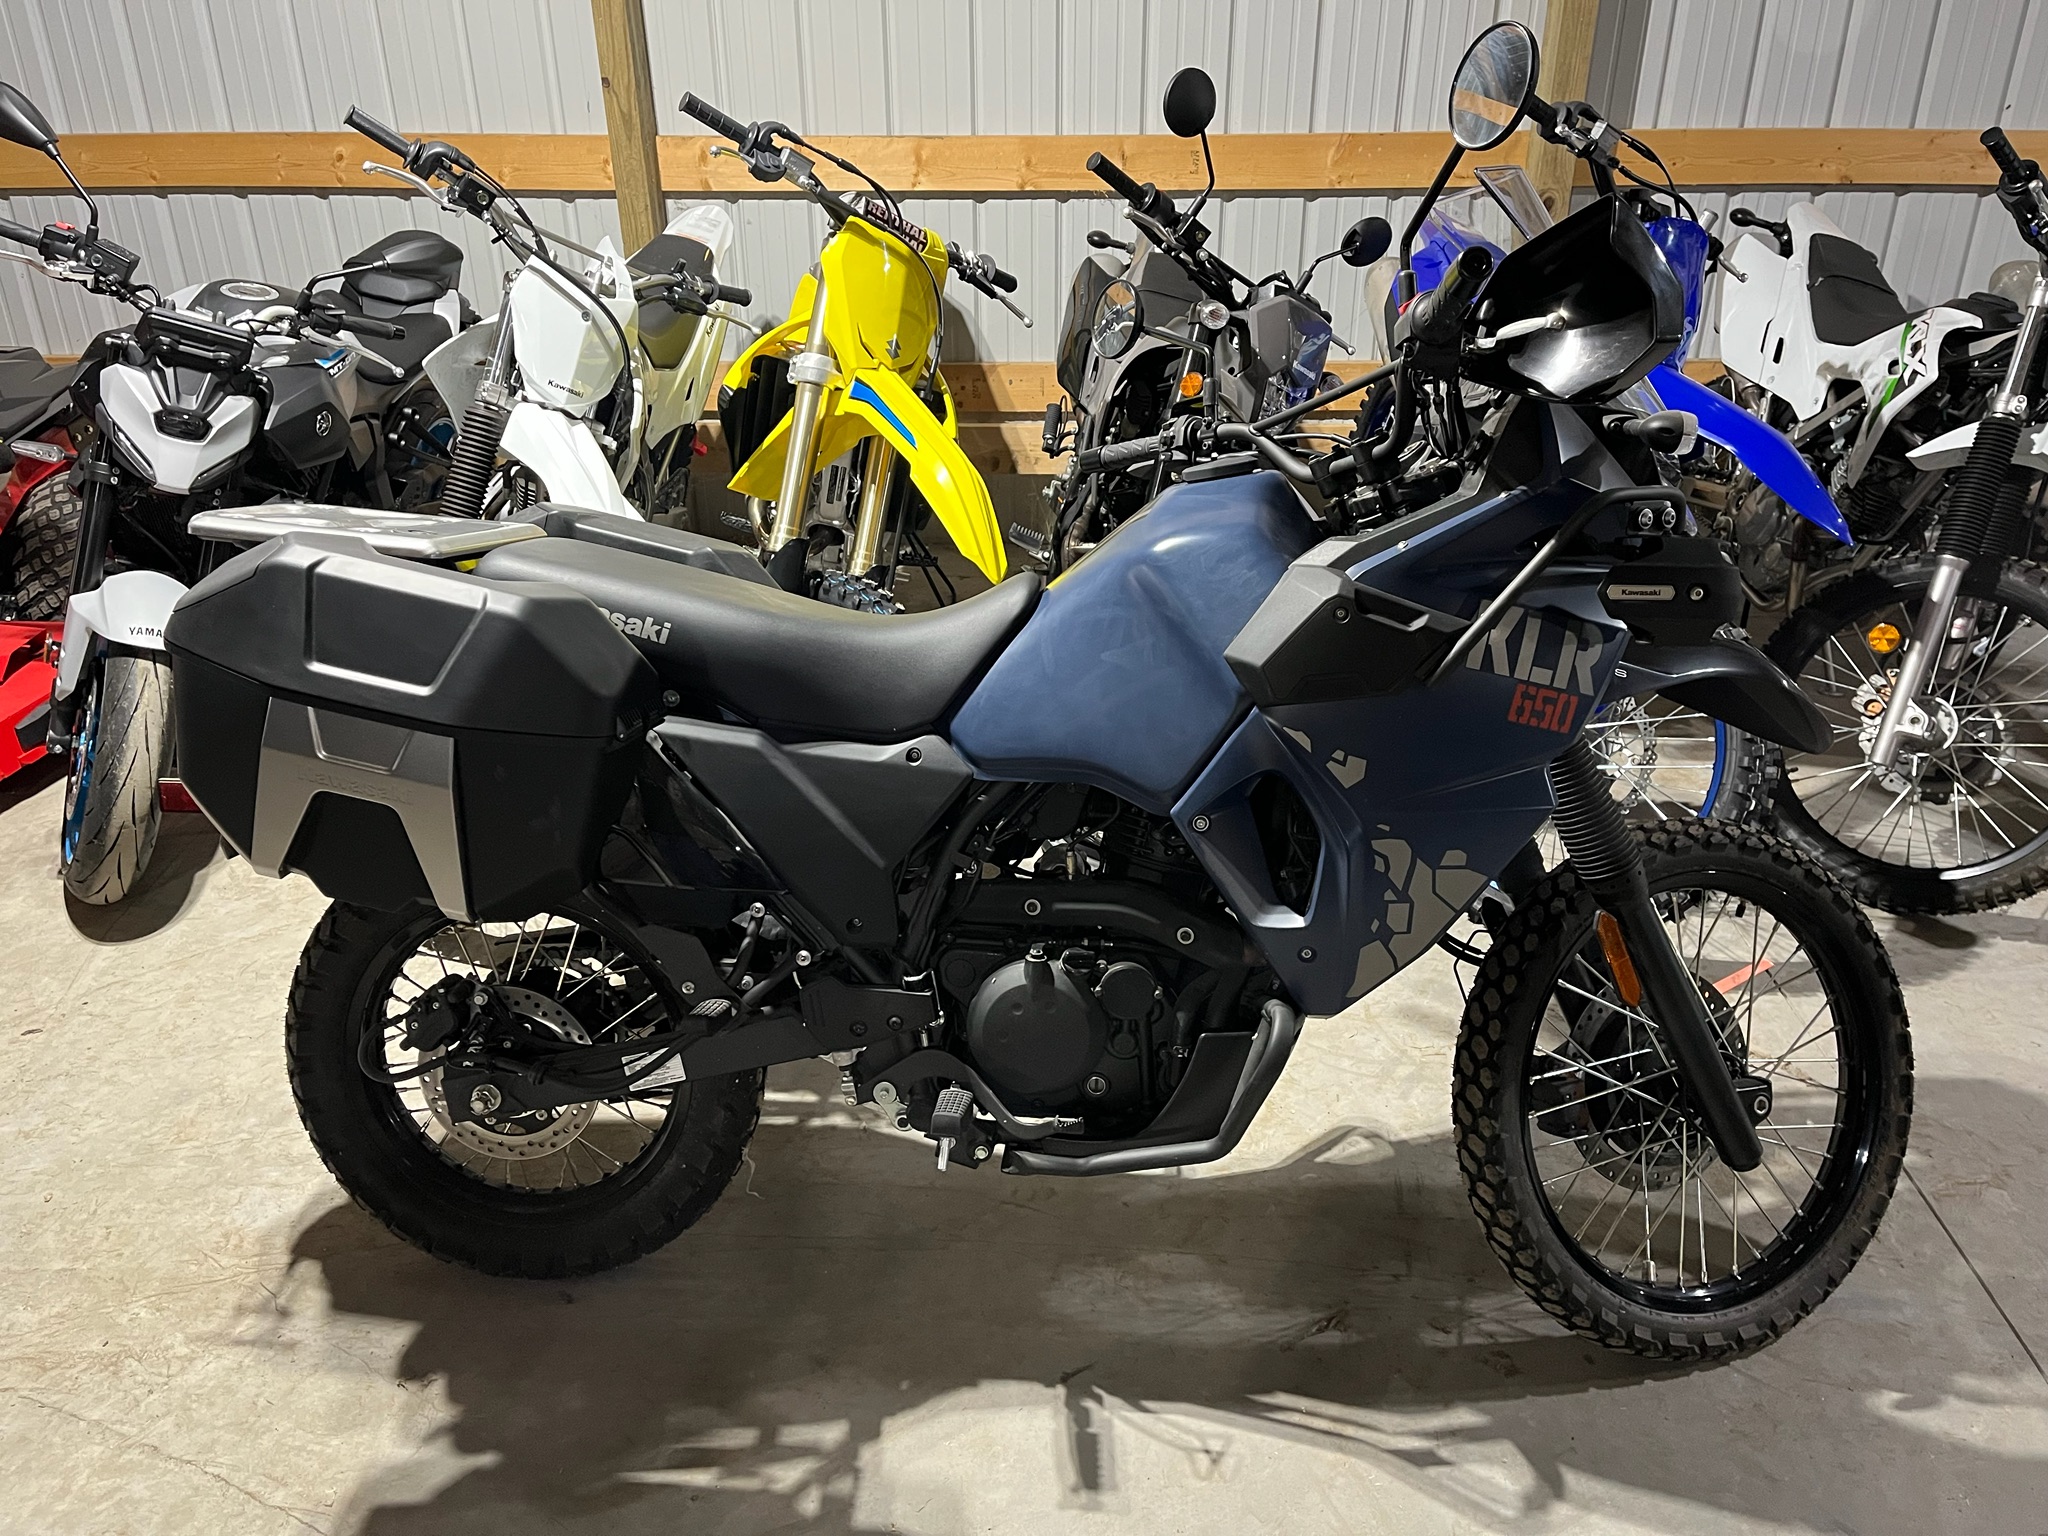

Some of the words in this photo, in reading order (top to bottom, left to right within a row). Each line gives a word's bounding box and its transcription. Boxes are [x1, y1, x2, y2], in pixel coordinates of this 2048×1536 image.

[547, 379, 585, 399] Kawasaki
[1621, 588, 1662, 597] Kawasaki
[1466, 600, 1595, 696] KLR
[1508, 682, 1579, 734] 650
